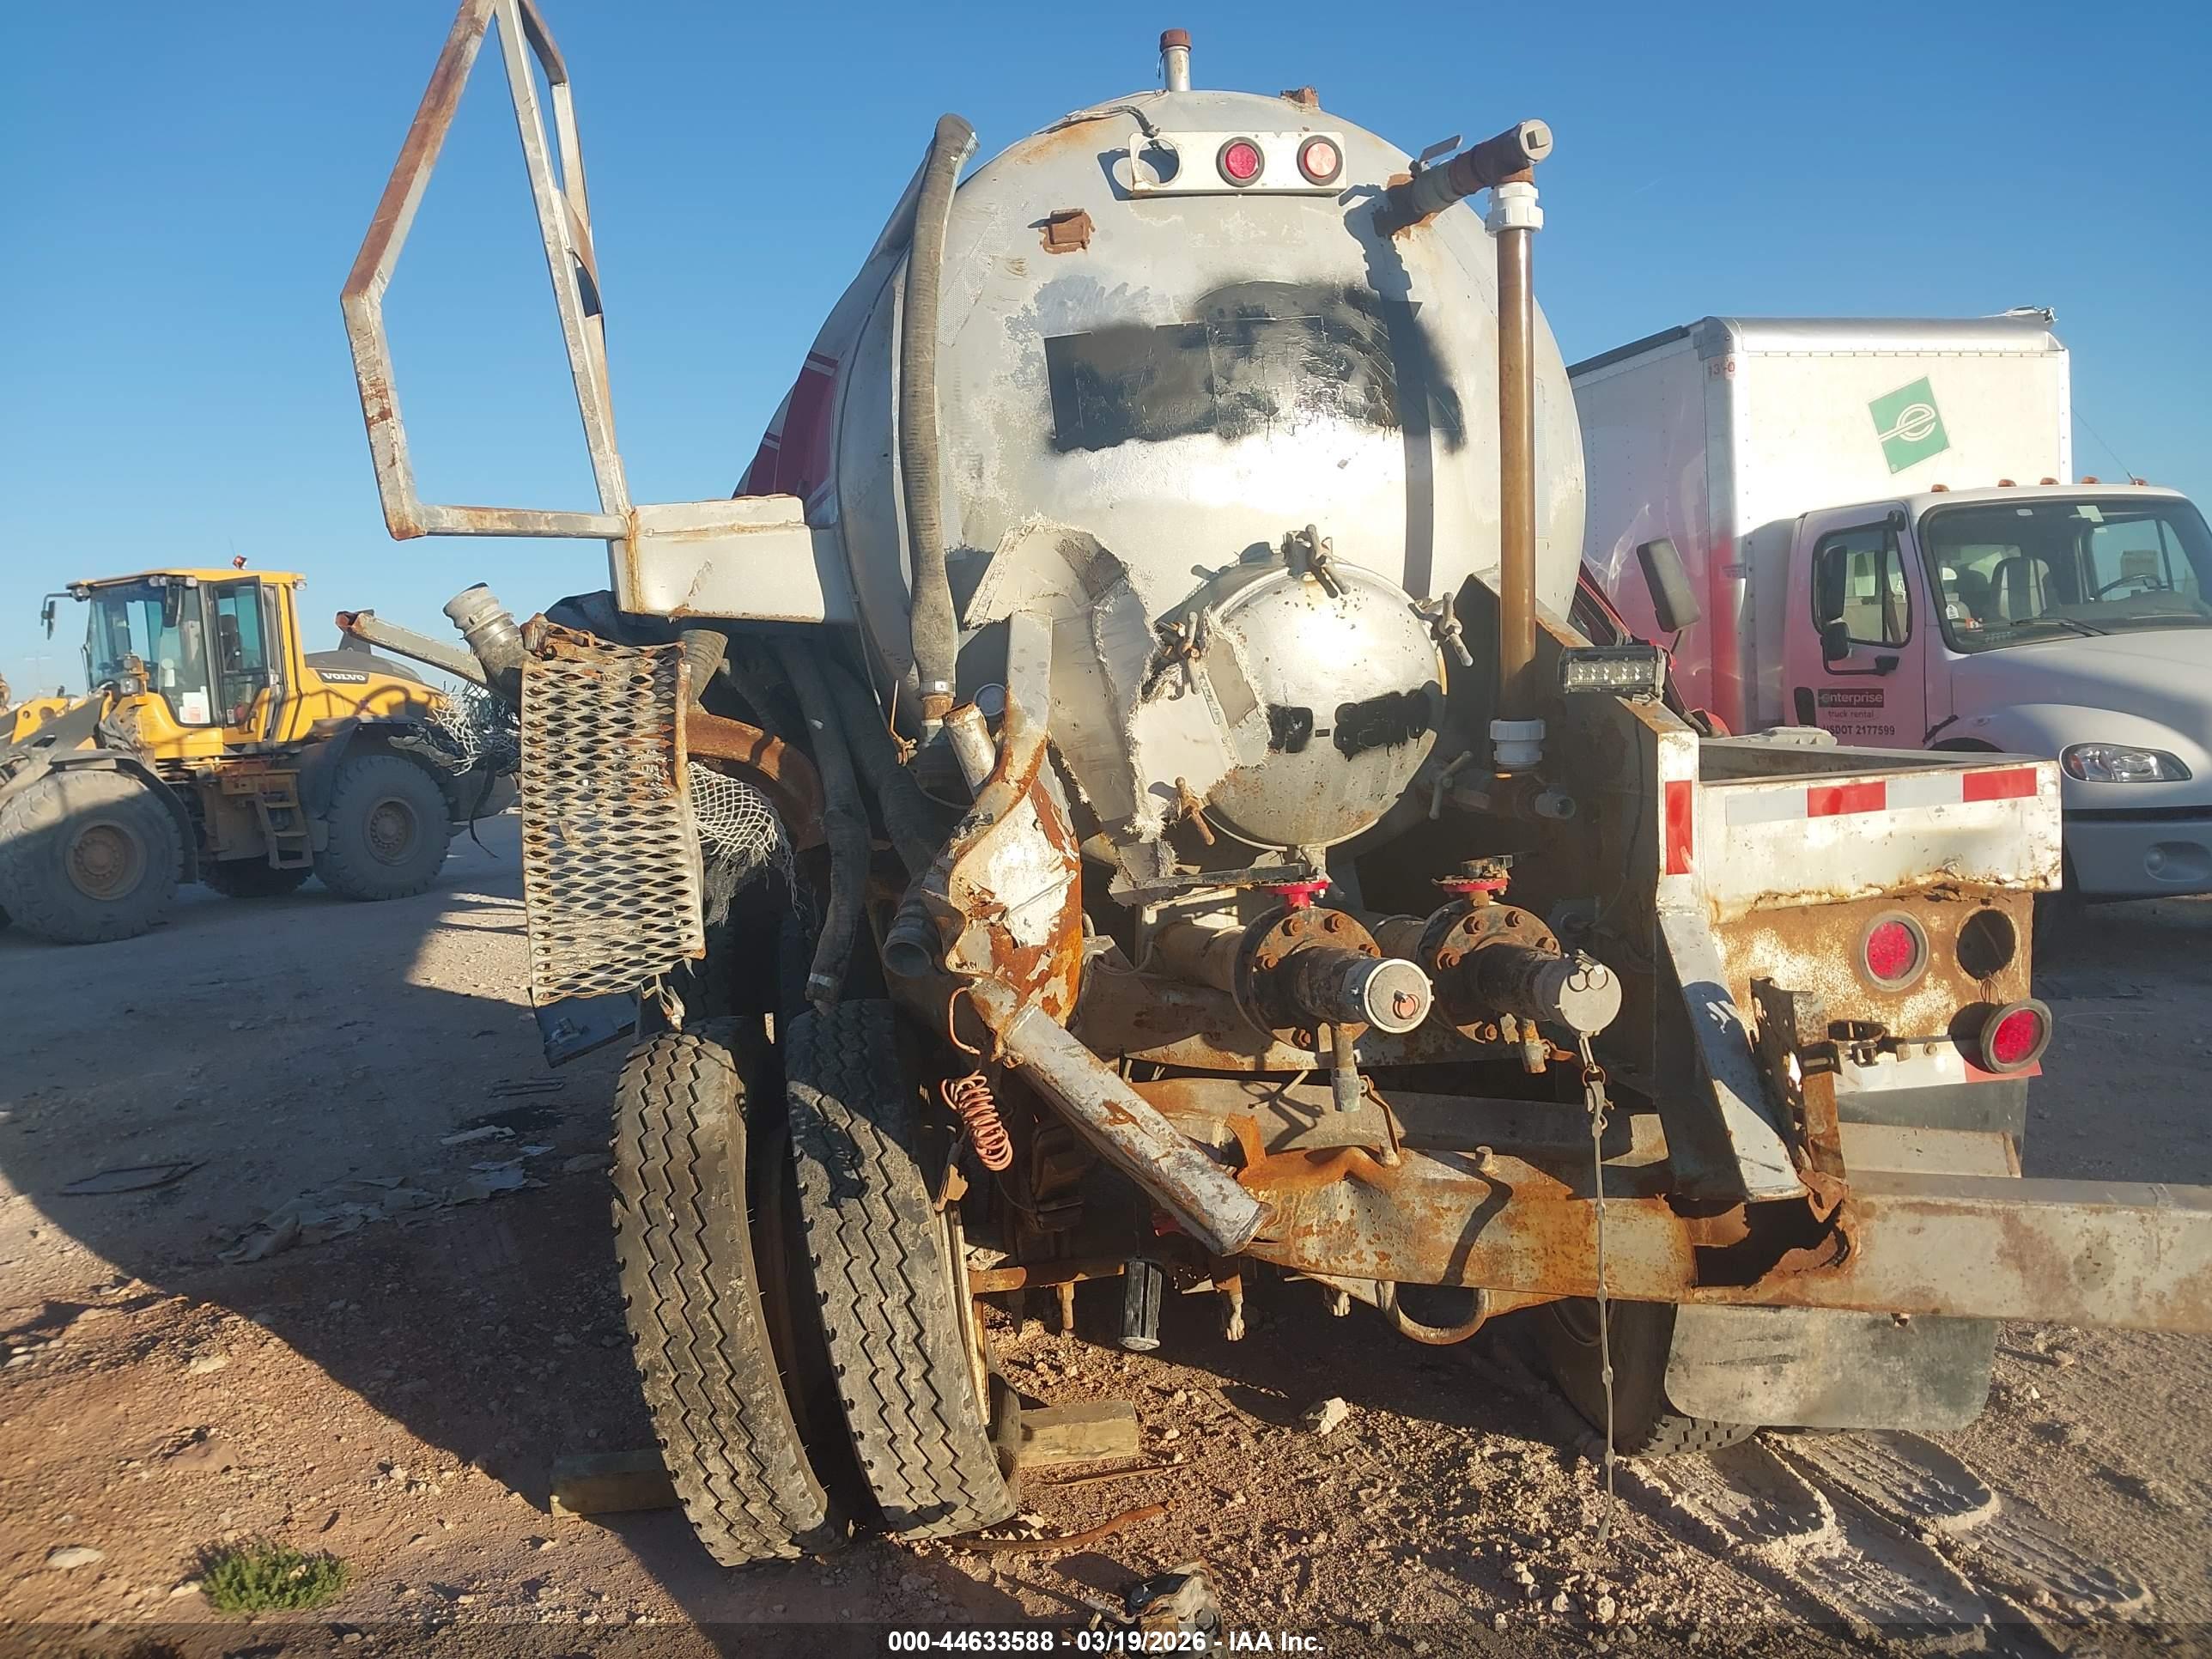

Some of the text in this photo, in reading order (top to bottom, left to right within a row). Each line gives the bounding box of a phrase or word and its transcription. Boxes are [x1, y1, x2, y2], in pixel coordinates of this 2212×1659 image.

[321, 672, 366, 681] VOLVO
[1818, 691, 1883, 705] enterprise
[1828, 709, 1874, 718] truck rental
[1856, 725, 1895, 735] 2177599
